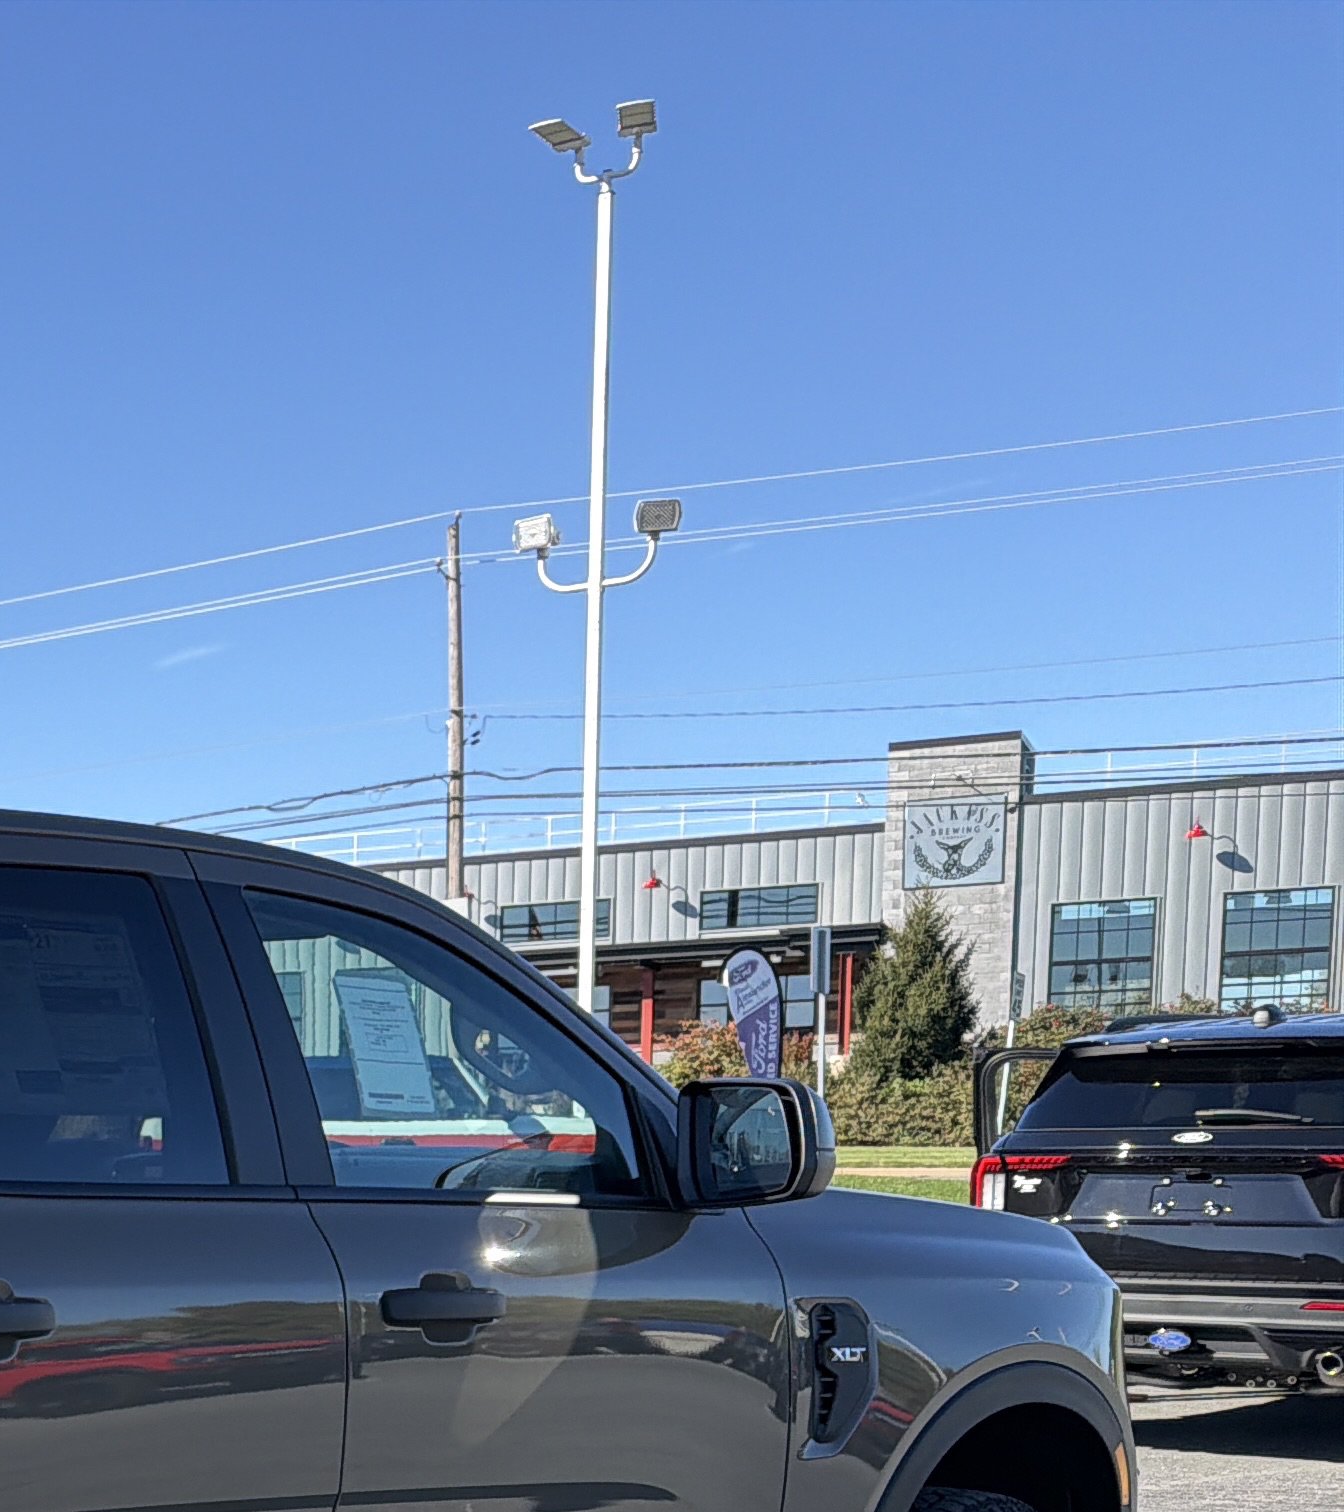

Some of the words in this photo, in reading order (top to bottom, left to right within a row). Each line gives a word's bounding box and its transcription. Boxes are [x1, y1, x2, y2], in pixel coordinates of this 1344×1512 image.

[930, 825, 981, 836] BREWING
[752, 1018, 768, 1075] Ford
[768, 1001, 779, 1059] SERVICE
[830, 1347, 867, 1363] XLT
